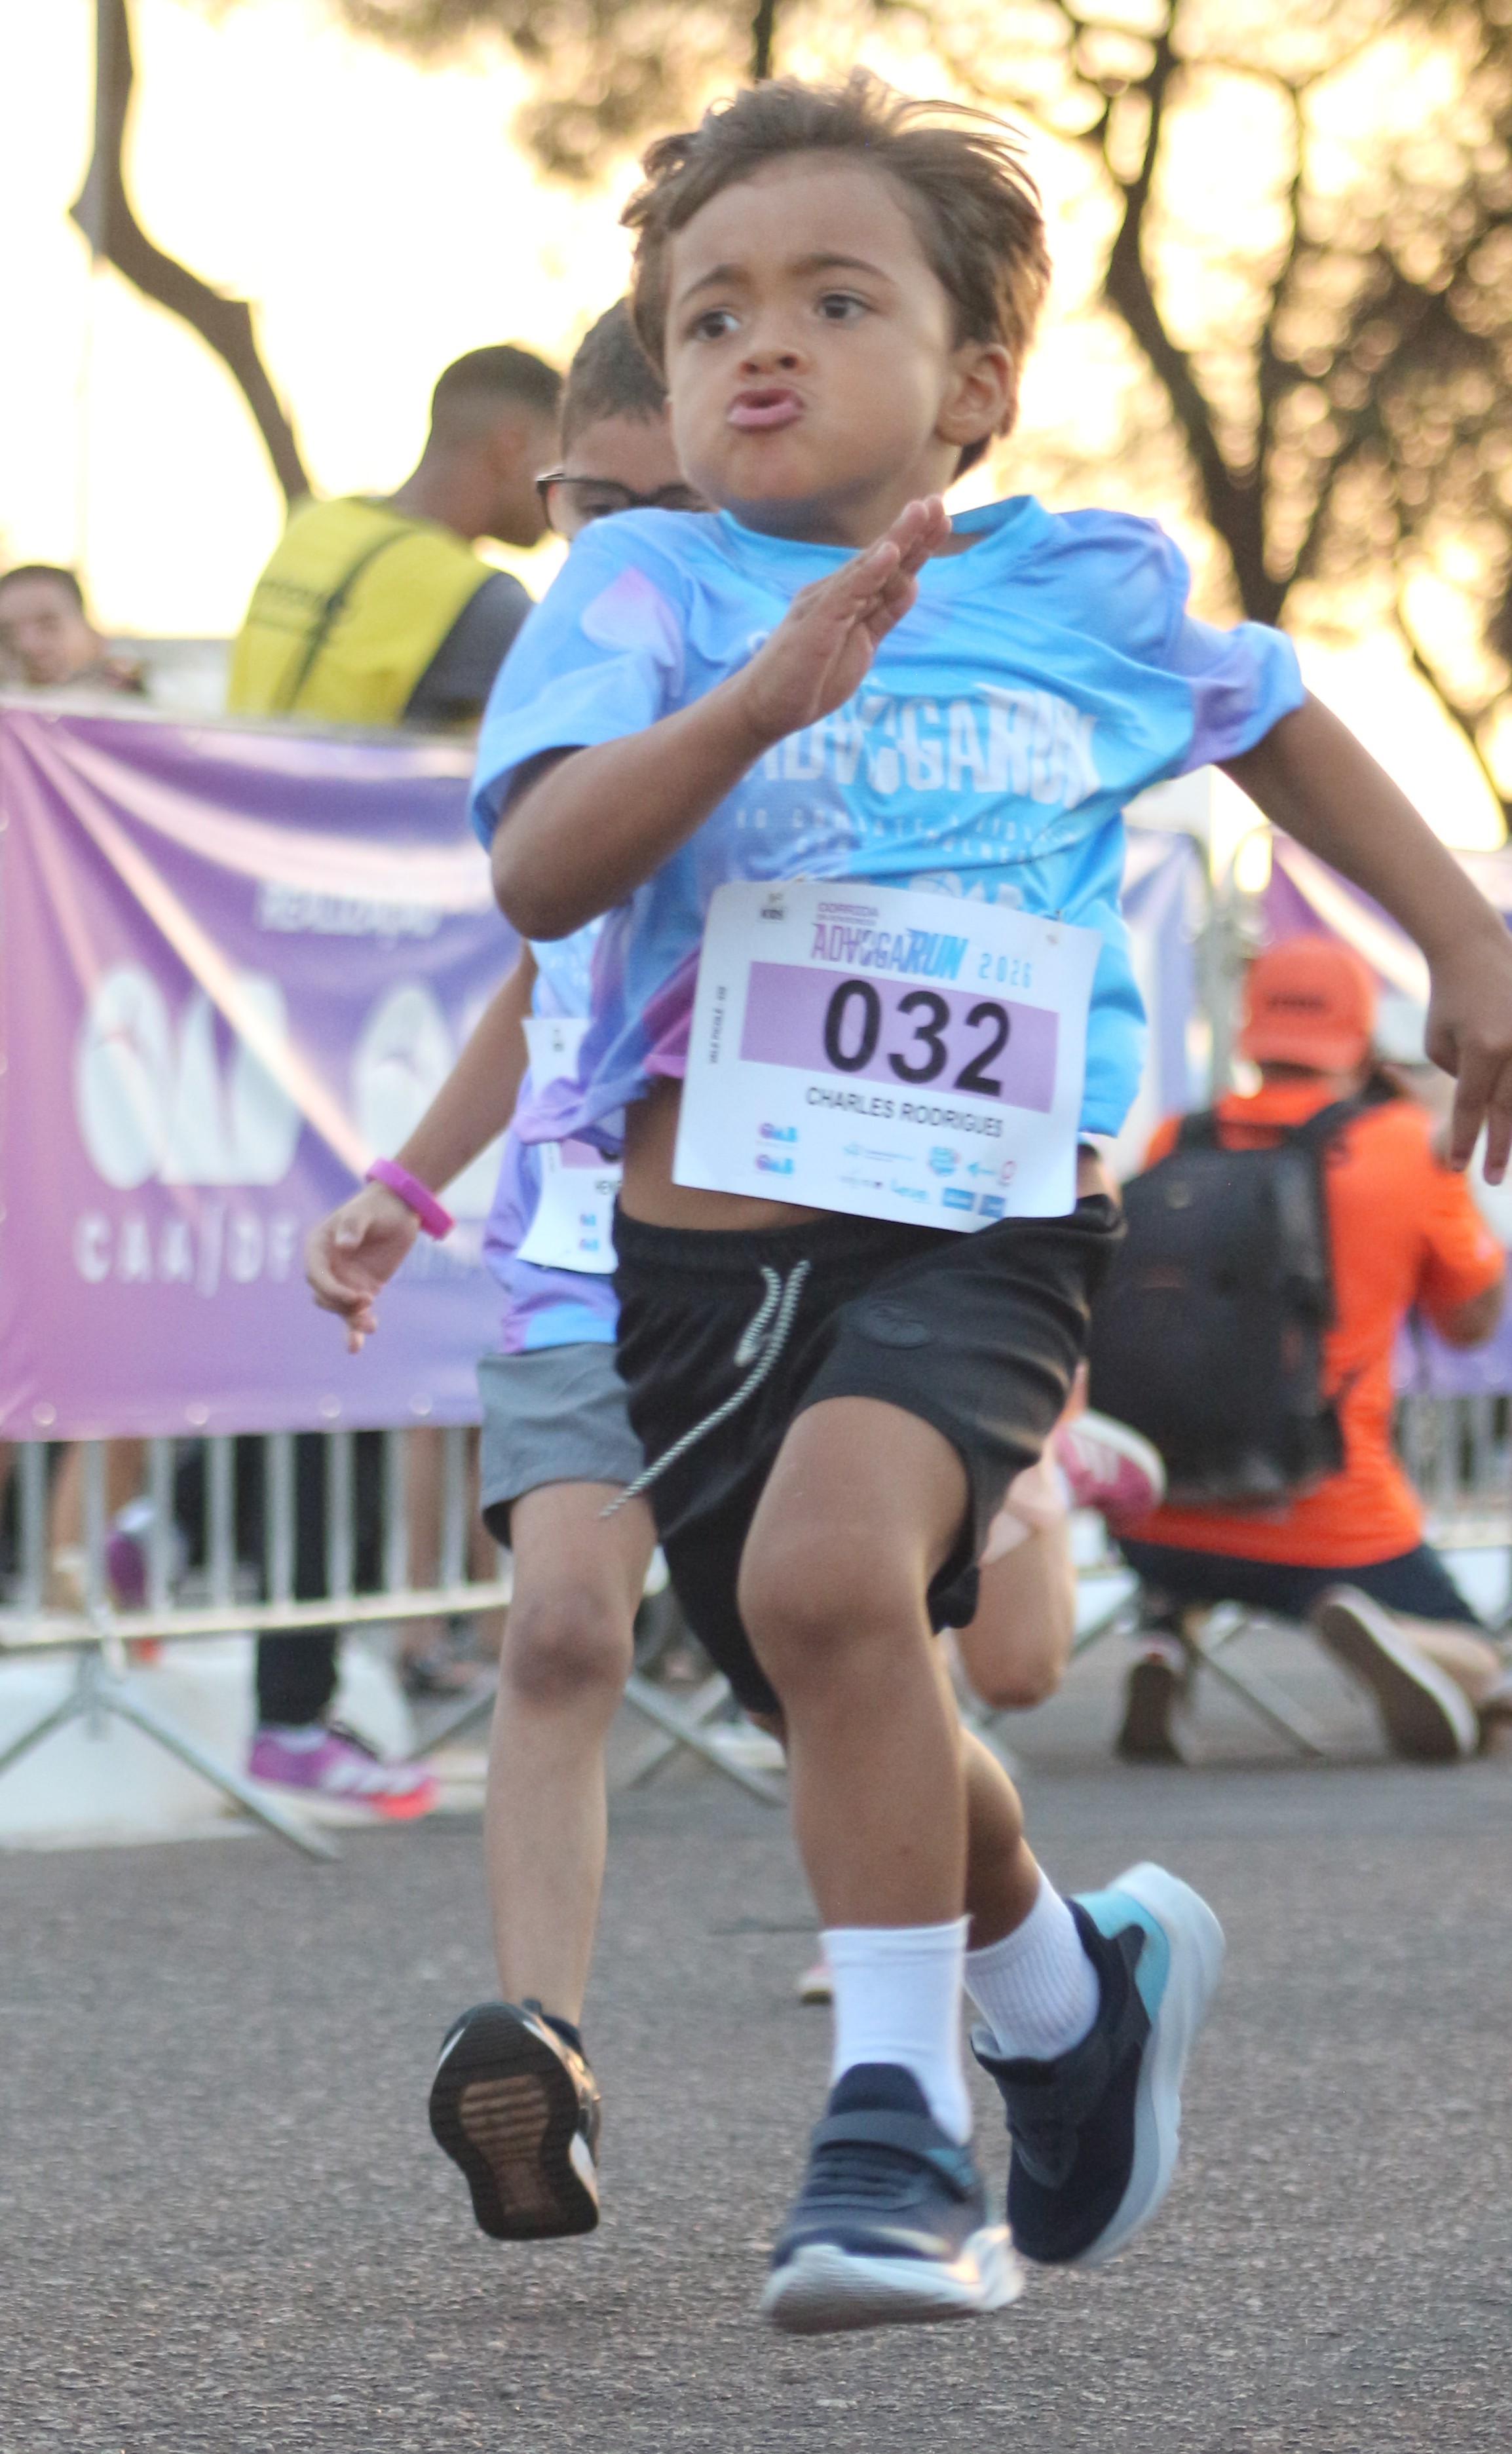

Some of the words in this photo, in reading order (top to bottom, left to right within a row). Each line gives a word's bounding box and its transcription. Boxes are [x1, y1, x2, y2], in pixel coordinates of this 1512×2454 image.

[811, 923, 969, 981] ADVOGARUN
[823, 979, 1011, 1097] 032
[806, 1086, 895, 1119] CHARLES
[900, 1103, 1004, 1138] RODRIGUES
